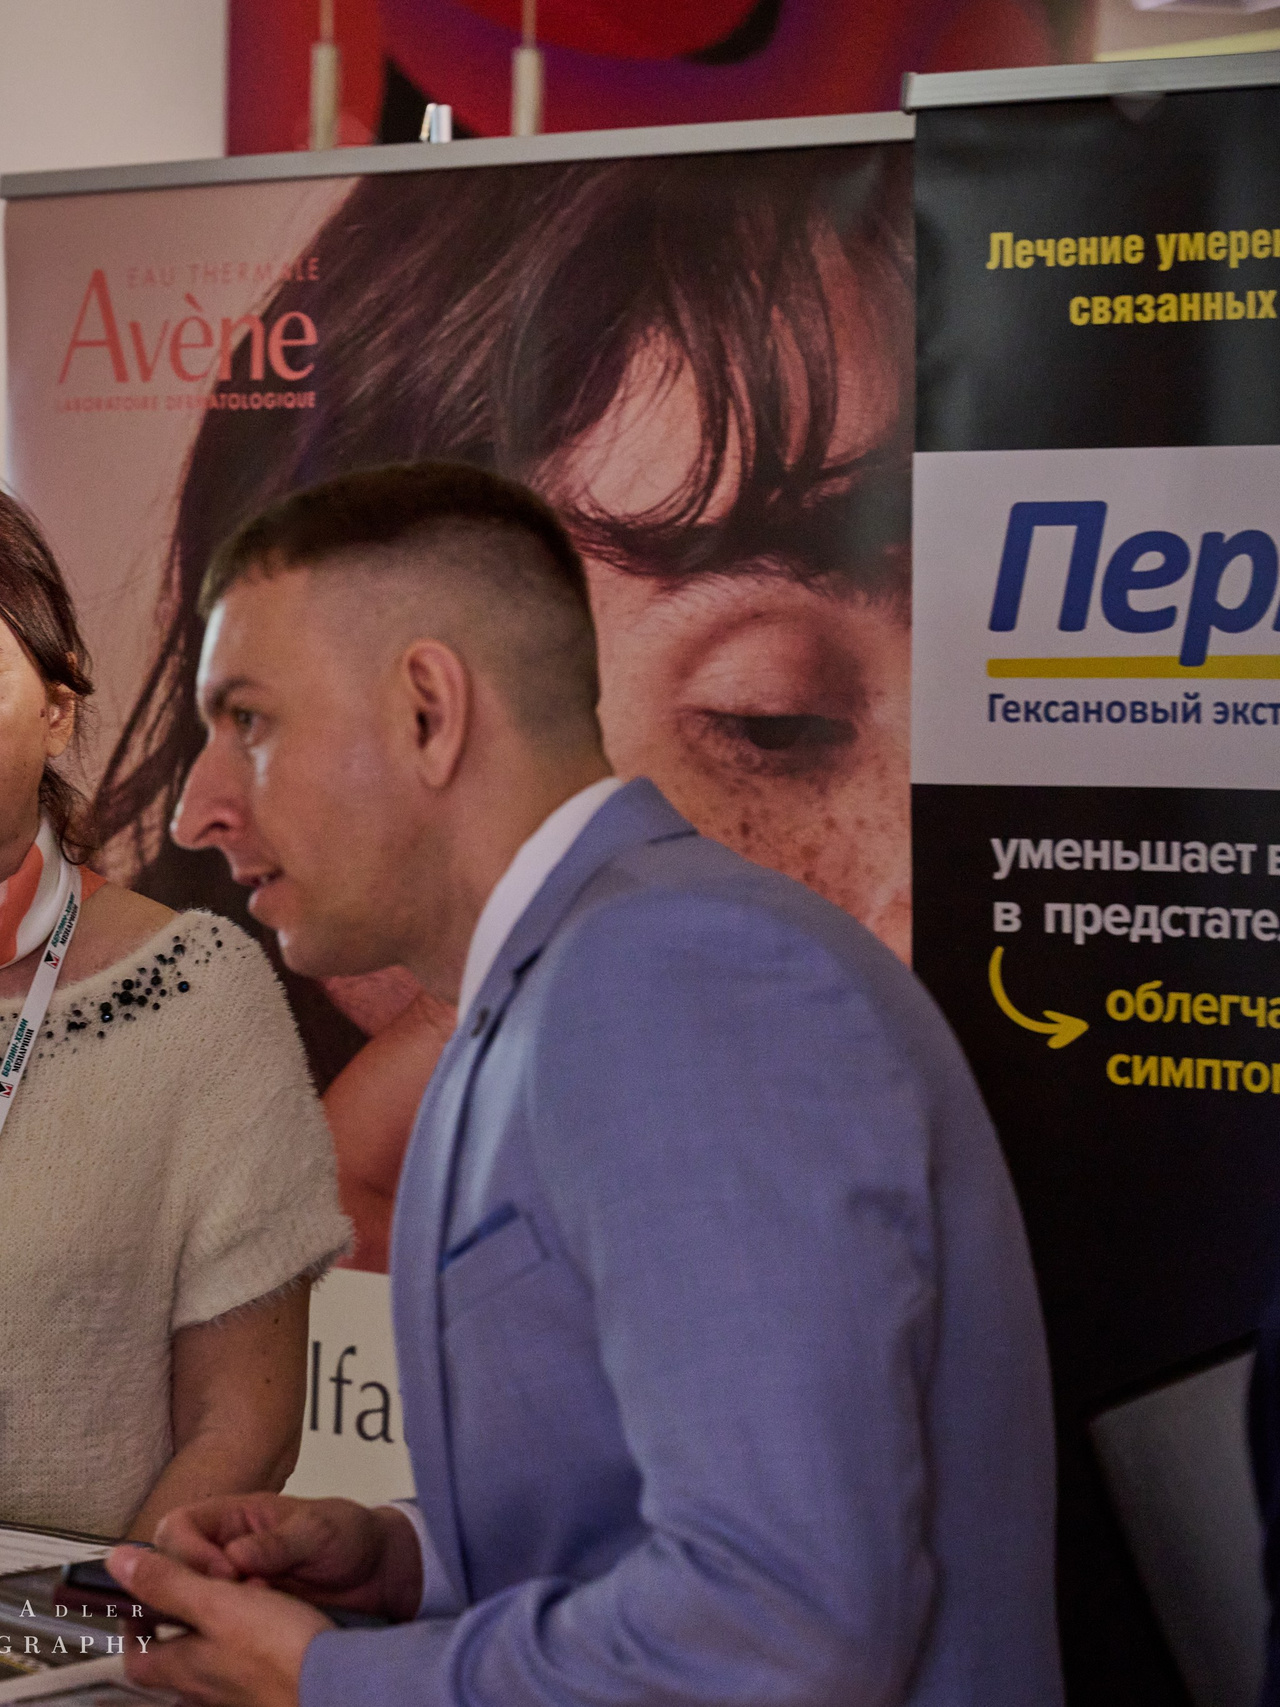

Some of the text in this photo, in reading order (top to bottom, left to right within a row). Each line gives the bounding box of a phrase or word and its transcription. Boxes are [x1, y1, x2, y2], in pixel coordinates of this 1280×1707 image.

[986, 231, 1144, 270] Лечение
[58, 267, 319, 385] Avène
[1069, 289, 1278, 326] связанных
[988, 499, 1280, 667] Пер
[987, 692, 1280, 726] Гексановый экст
[989, 837, 1258, 880] уменьшает
[993, 901, 1280, 945] в предстате
[1106, 1053, 1280, 1095] симпто
